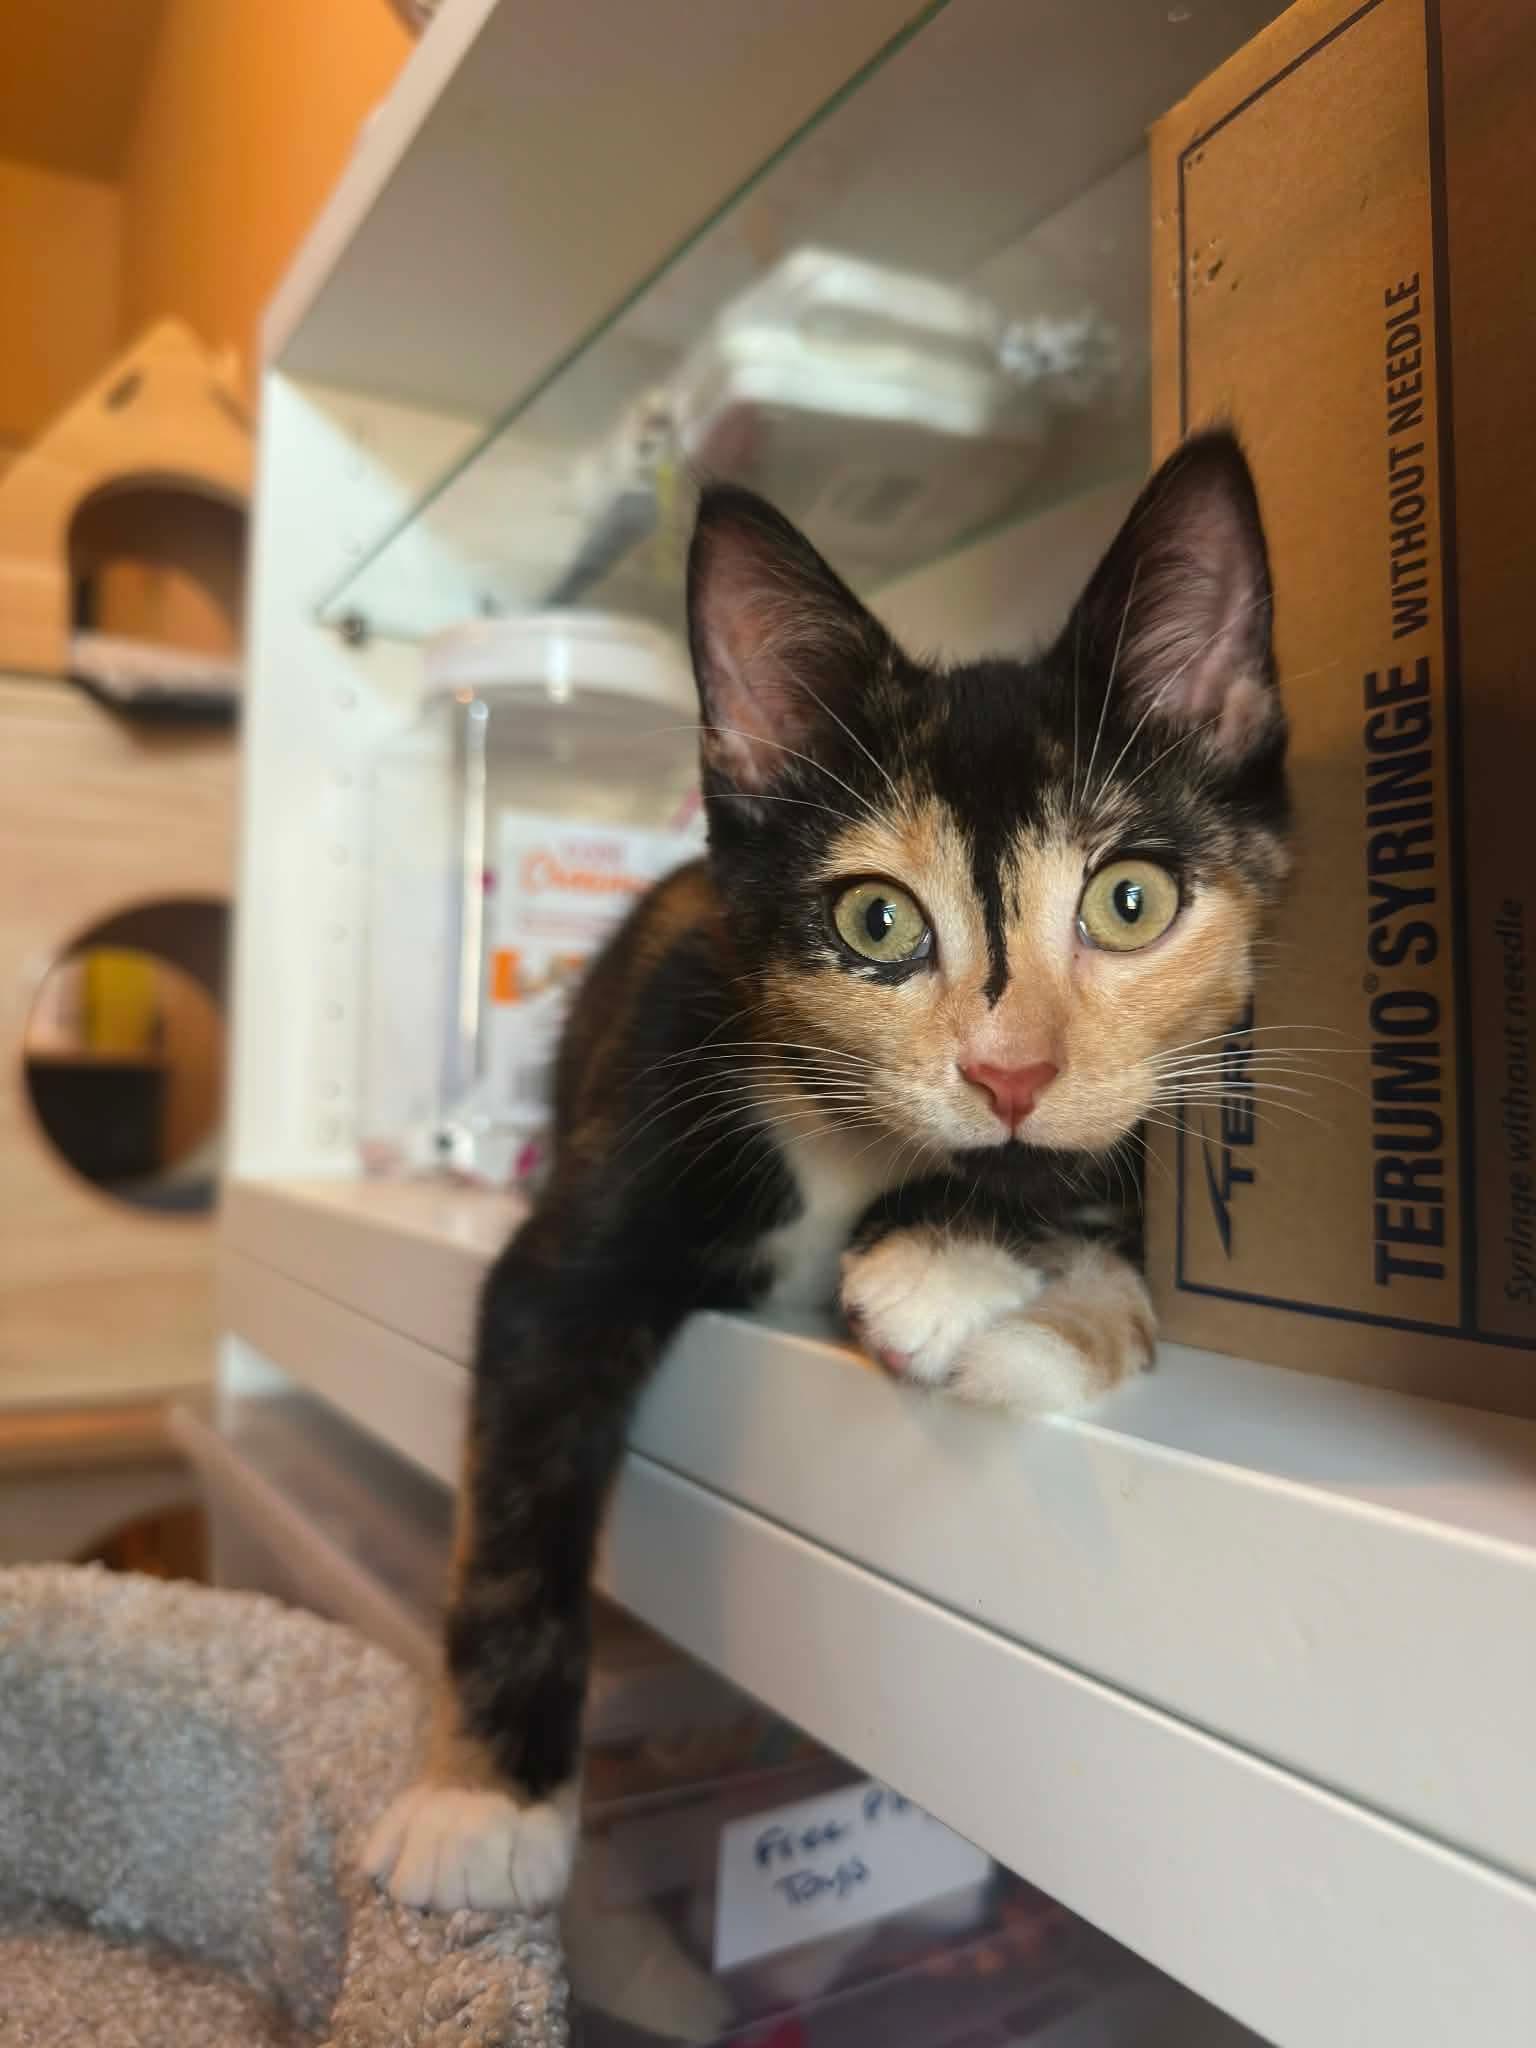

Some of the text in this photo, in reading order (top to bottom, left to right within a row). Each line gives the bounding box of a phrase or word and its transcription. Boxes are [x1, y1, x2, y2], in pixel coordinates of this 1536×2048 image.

[1384, 271, 1425, 437] NEEDLE
[1388, 440, 1430, 641] WITHOUT
[1363, 655, 1439, 968] SYRINGE
[1494, 899, 1536, 1304] Syringe without needle
